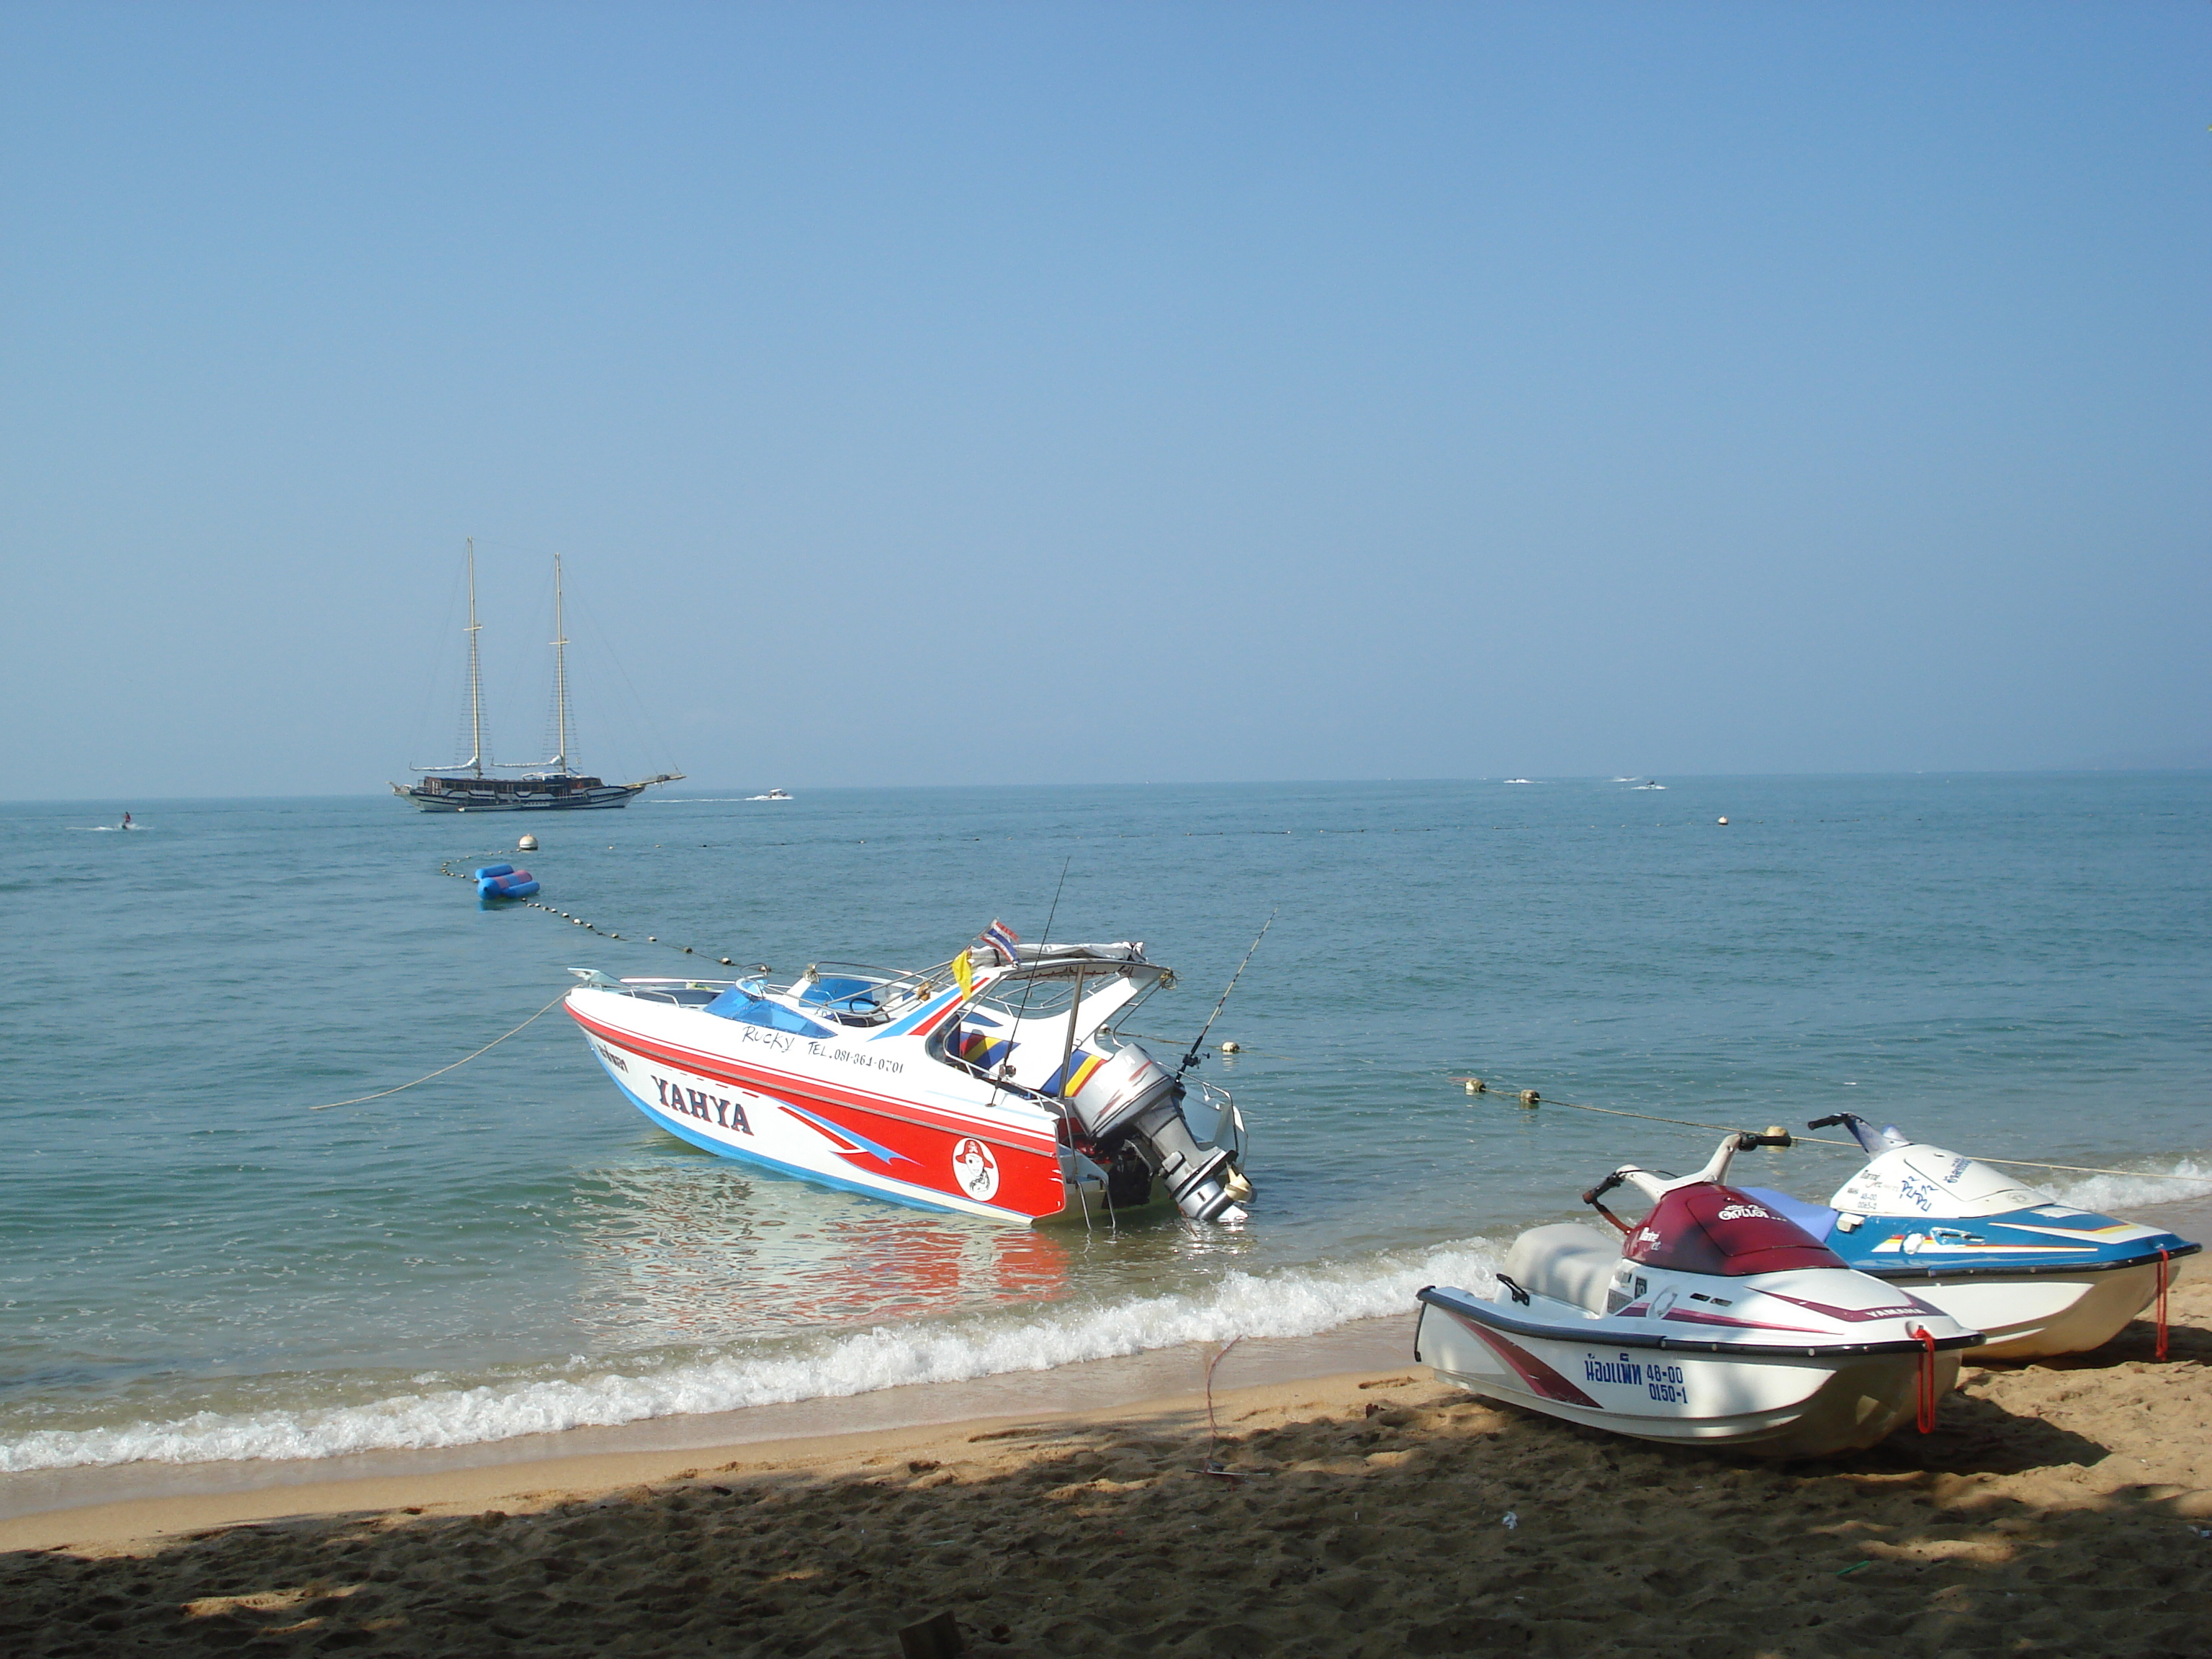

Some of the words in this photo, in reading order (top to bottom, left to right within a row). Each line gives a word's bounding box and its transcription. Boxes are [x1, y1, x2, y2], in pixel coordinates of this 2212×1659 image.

[650, 1074, 755, 1136] YAHYA
[1864, 1308, 1928, 1318] YAMAHA
[1646, 1364, 1683, 1384] 48-00
[1649, 1382, 1688, 1404] 0150-1
